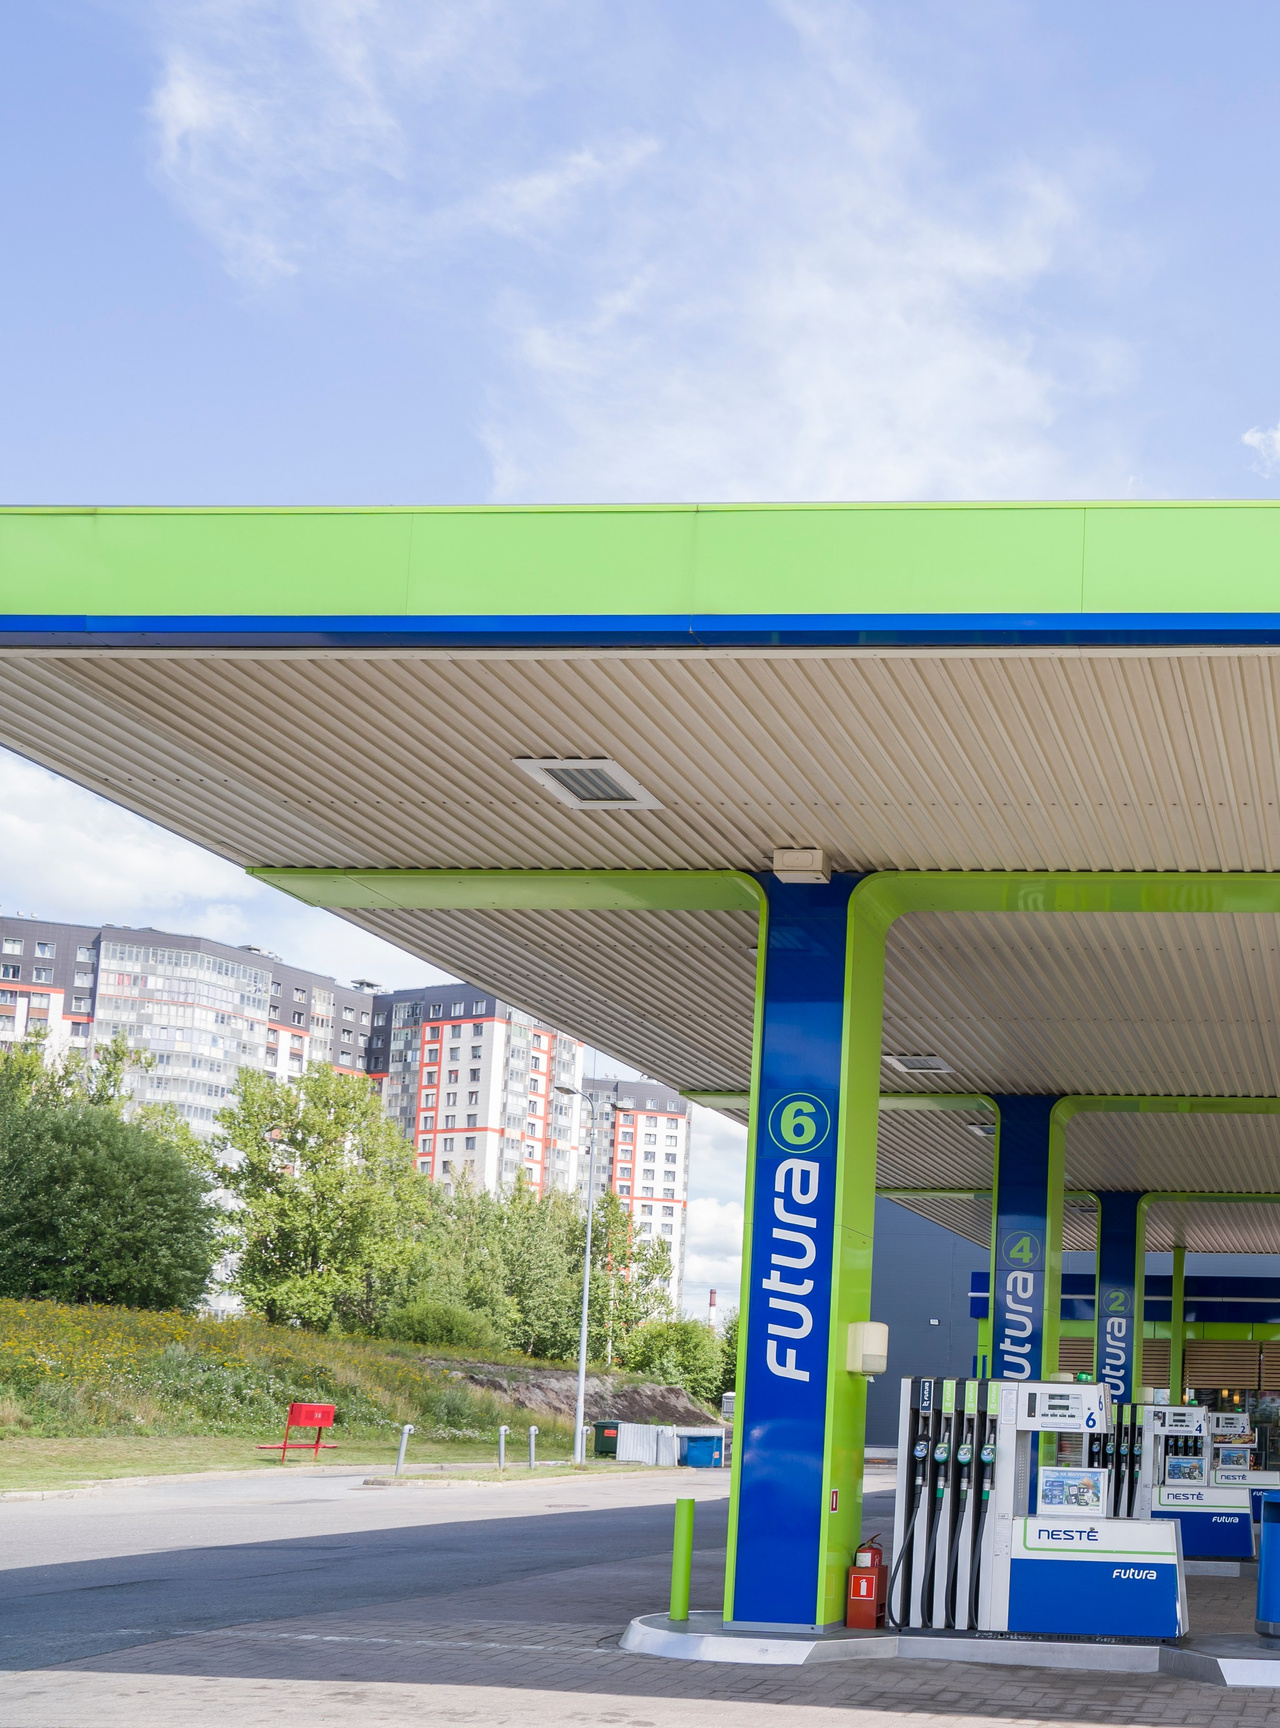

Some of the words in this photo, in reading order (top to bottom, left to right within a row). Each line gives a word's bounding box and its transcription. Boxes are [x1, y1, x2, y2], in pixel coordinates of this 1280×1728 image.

[780, 1101, 816, 1145] 6
[1009, 1236, 1033, 1263] 4
[762, 1158, 820, 1383] Futura
[1108, 1292, 1125, 1311] 2
[1000, 1270, 1034, 1380] utura
[1102, 1316, 1127, 1404] utura
[1085, 1412, 1096, 1428] 6
[1195, 1424, 1202, 1433] 4
[1167, 1492, 1204, 1500] NESTE
[1038, 1529, 1099, 1541] NESTE
[1112, 1568, 1157, 1580] Futura
